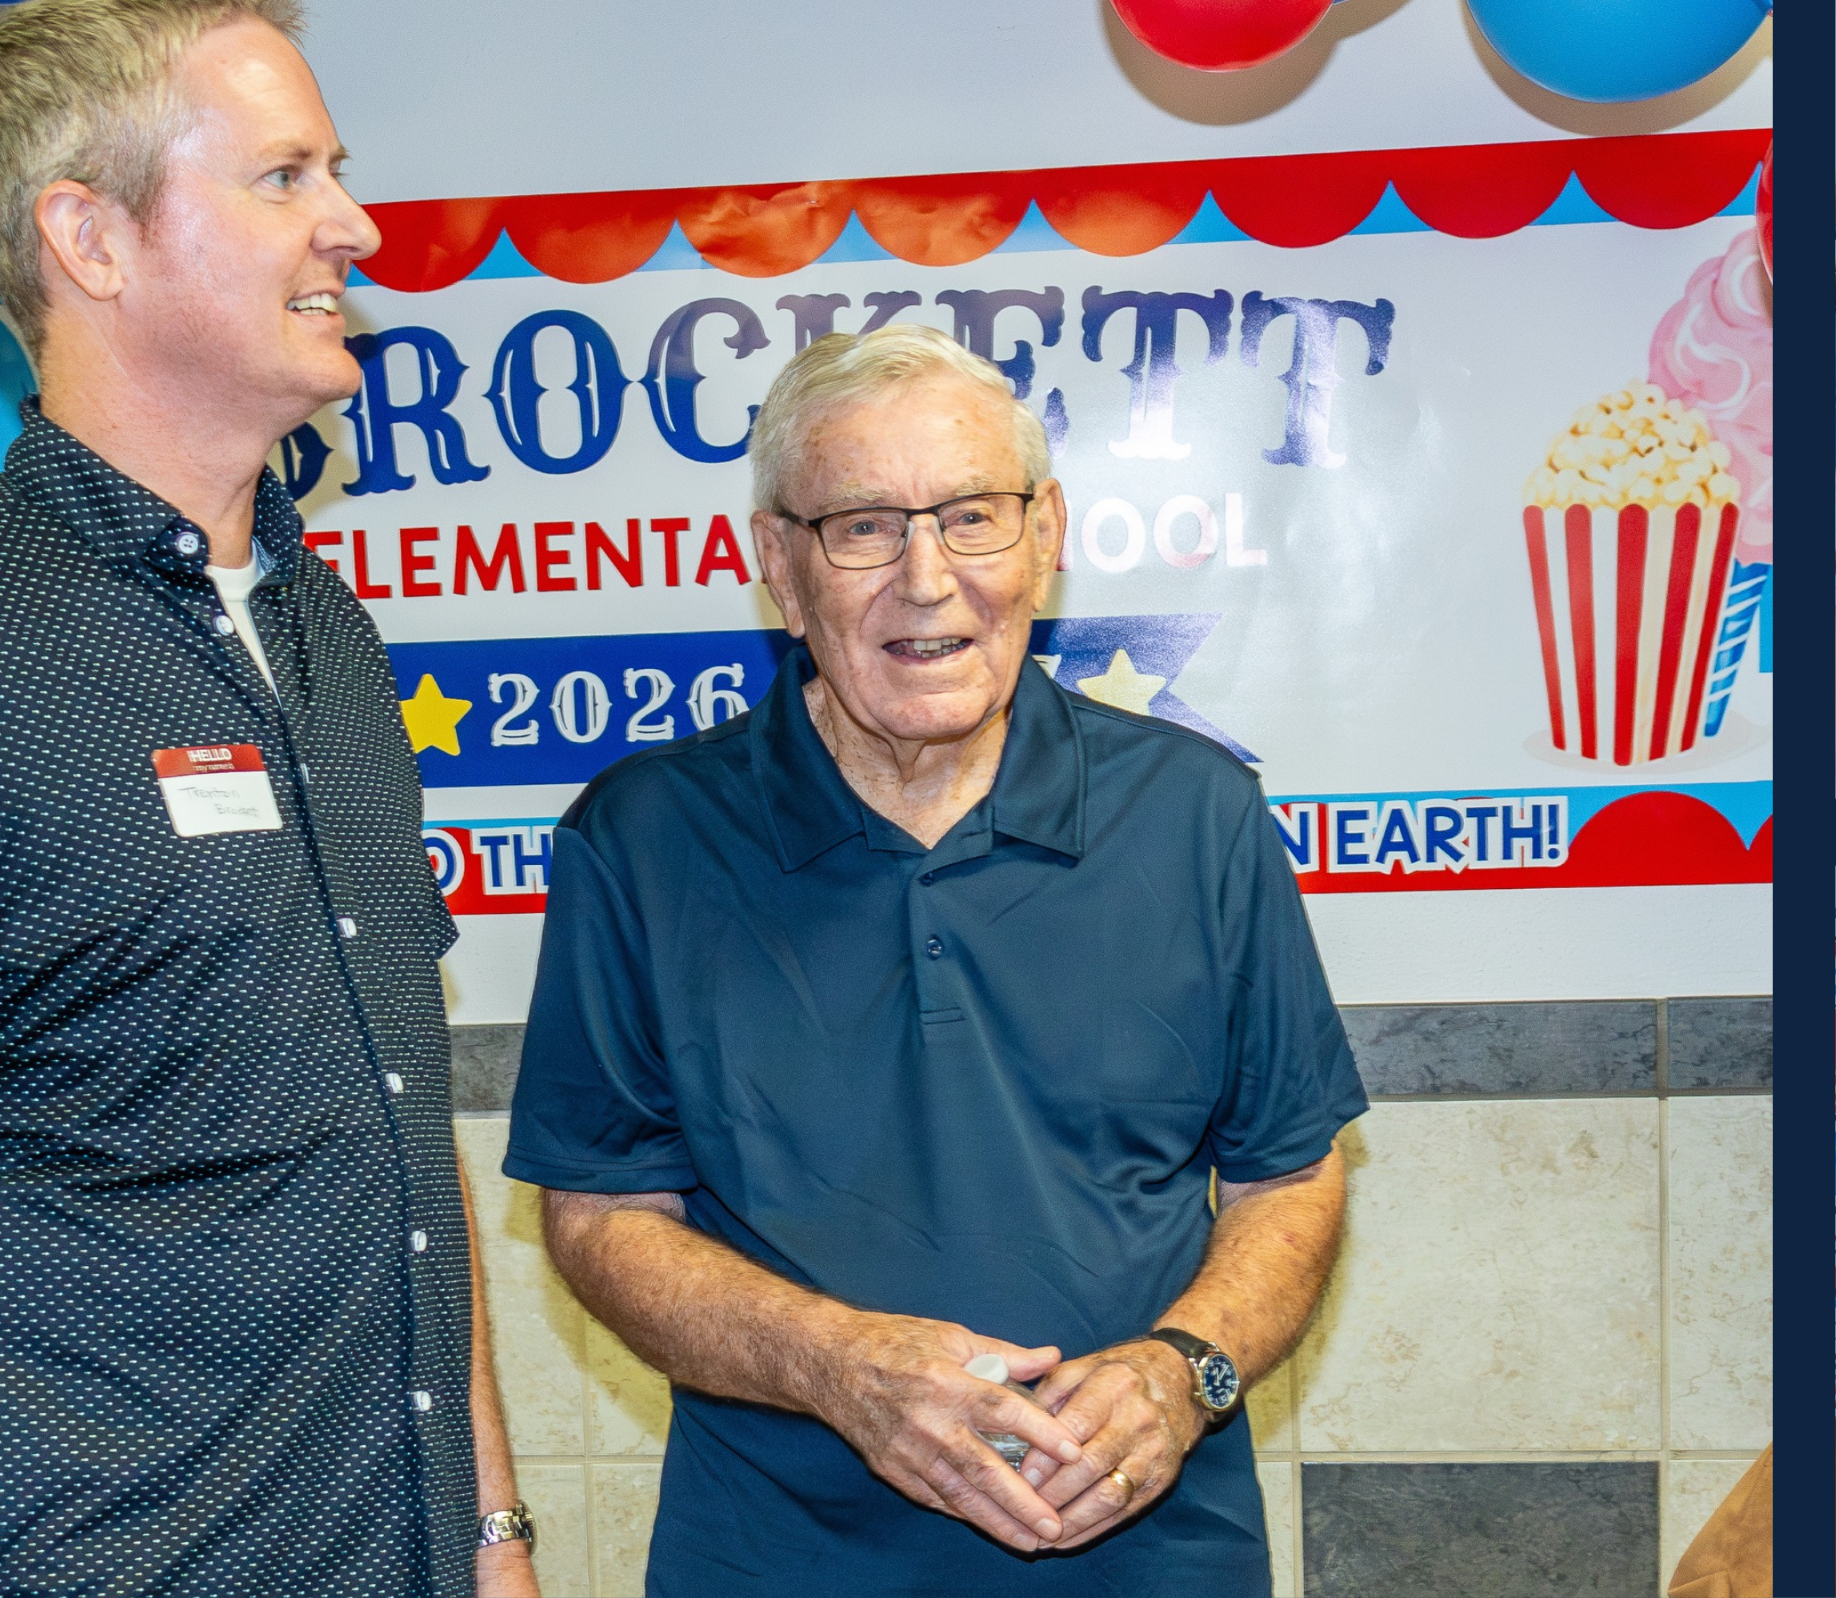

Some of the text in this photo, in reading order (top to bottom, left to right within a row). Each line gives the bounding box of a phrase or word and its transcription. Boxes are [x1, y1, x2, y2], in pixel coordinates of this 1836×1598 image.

[304, 514, 766, 599] ELEMENTA
[187, 748, 232, 762] HELLO
[479, 833, 553, 887] TH
[1274, 811, 1310, 865] N
[1336, 803, 1561, 865] EARTH!
